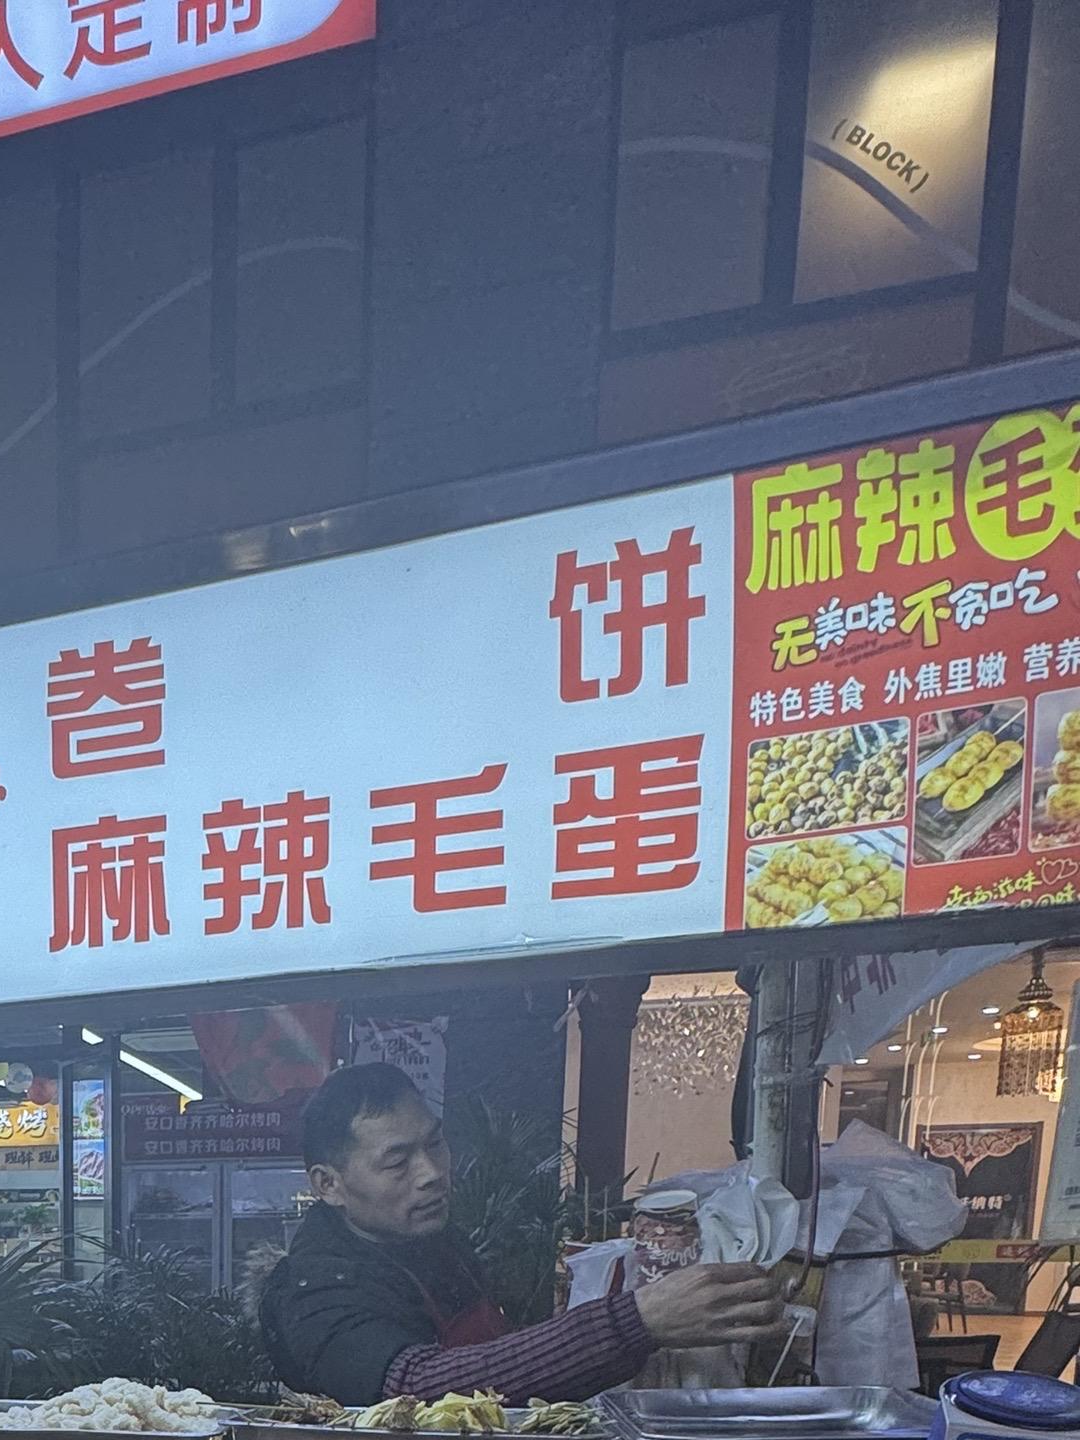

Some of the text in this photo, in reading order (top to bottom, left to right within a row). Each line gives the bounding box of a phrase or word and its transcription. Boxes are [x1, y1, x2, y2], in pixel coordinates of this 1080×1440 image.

[745, 412, 1080, 594] 麻辣毛
[47, 526, 706, 779] 卷 饼
[749, 675, 867, 728] 特色美食
[883, 650, 1008, 706] 外焦里嫩
[771, 566, 1060, 671] 无美味不贪吃
[48, 733, 705, 953] 麻辣毛蛋
